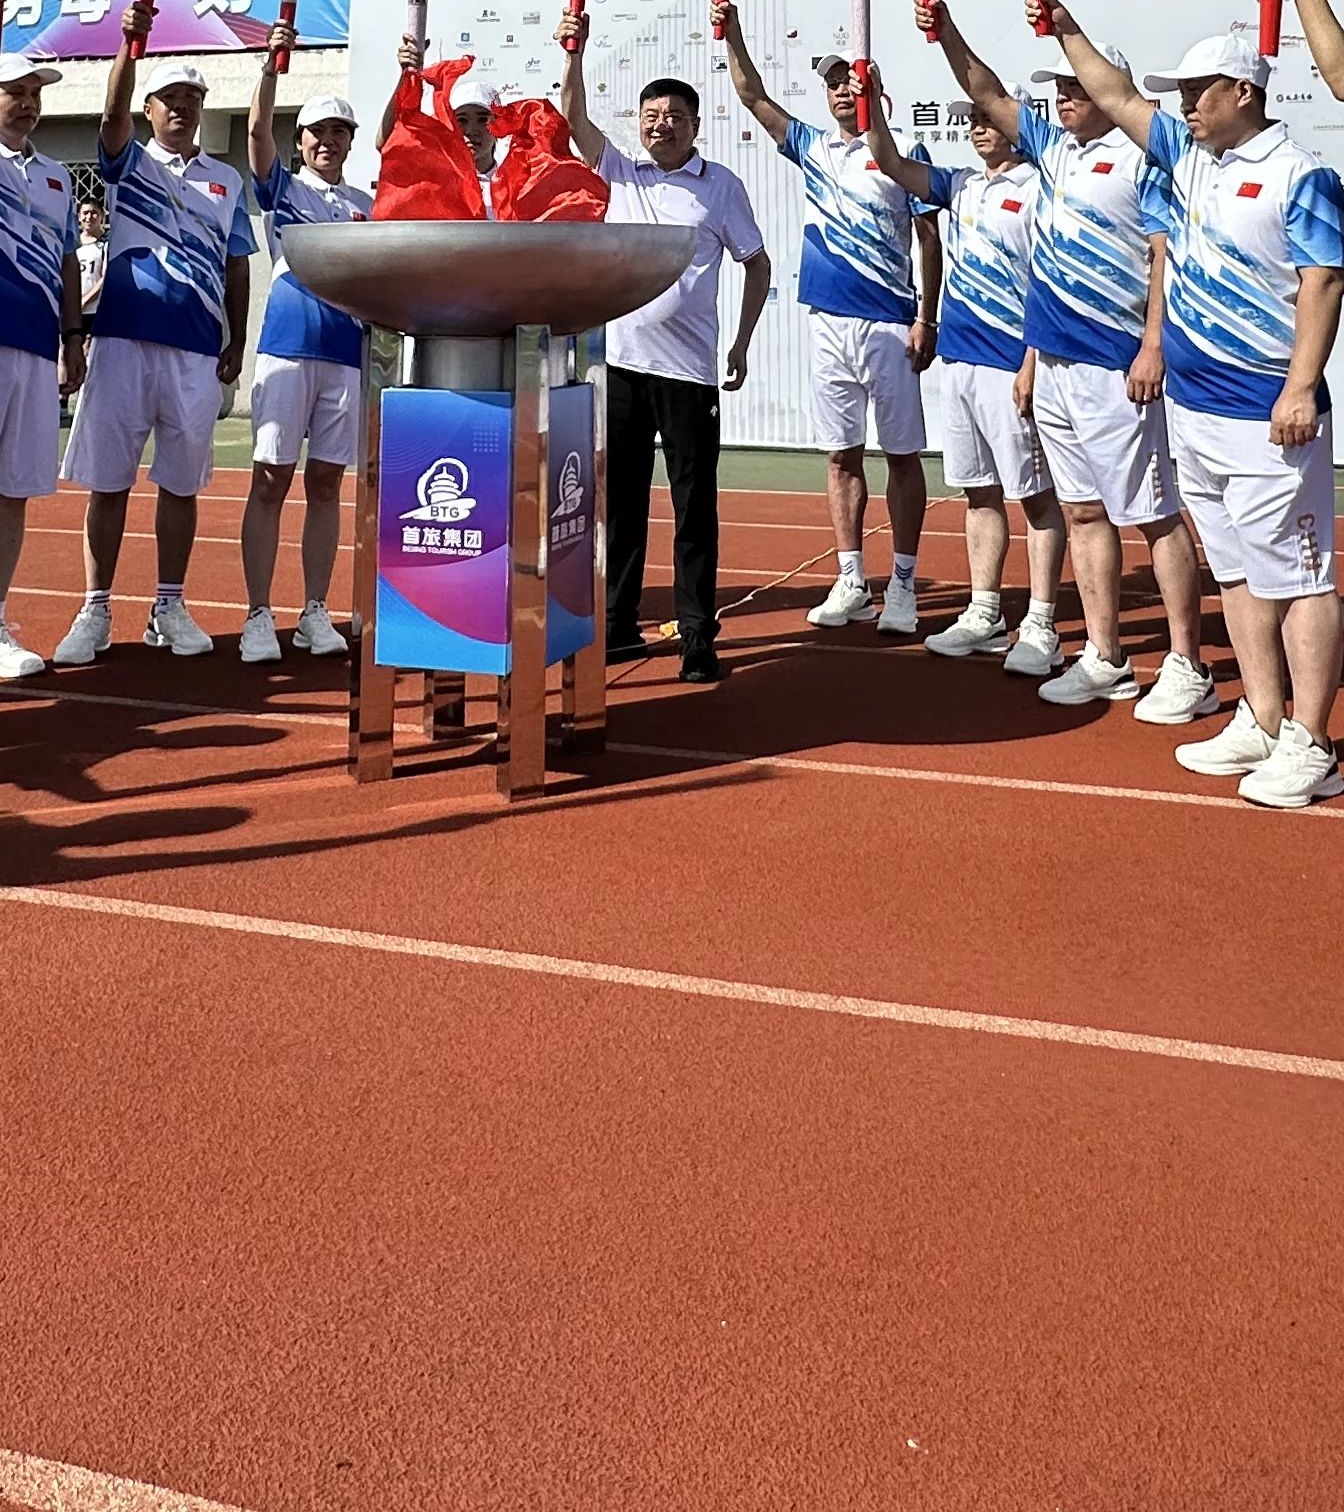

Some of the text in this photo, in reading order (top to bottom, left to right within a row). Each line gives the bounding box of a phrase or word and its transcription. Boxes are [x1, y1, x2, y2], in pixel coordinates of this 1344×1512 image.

[430, 506, 460, 518] BTG
[402, 525, 482, 549] 首旅集团
